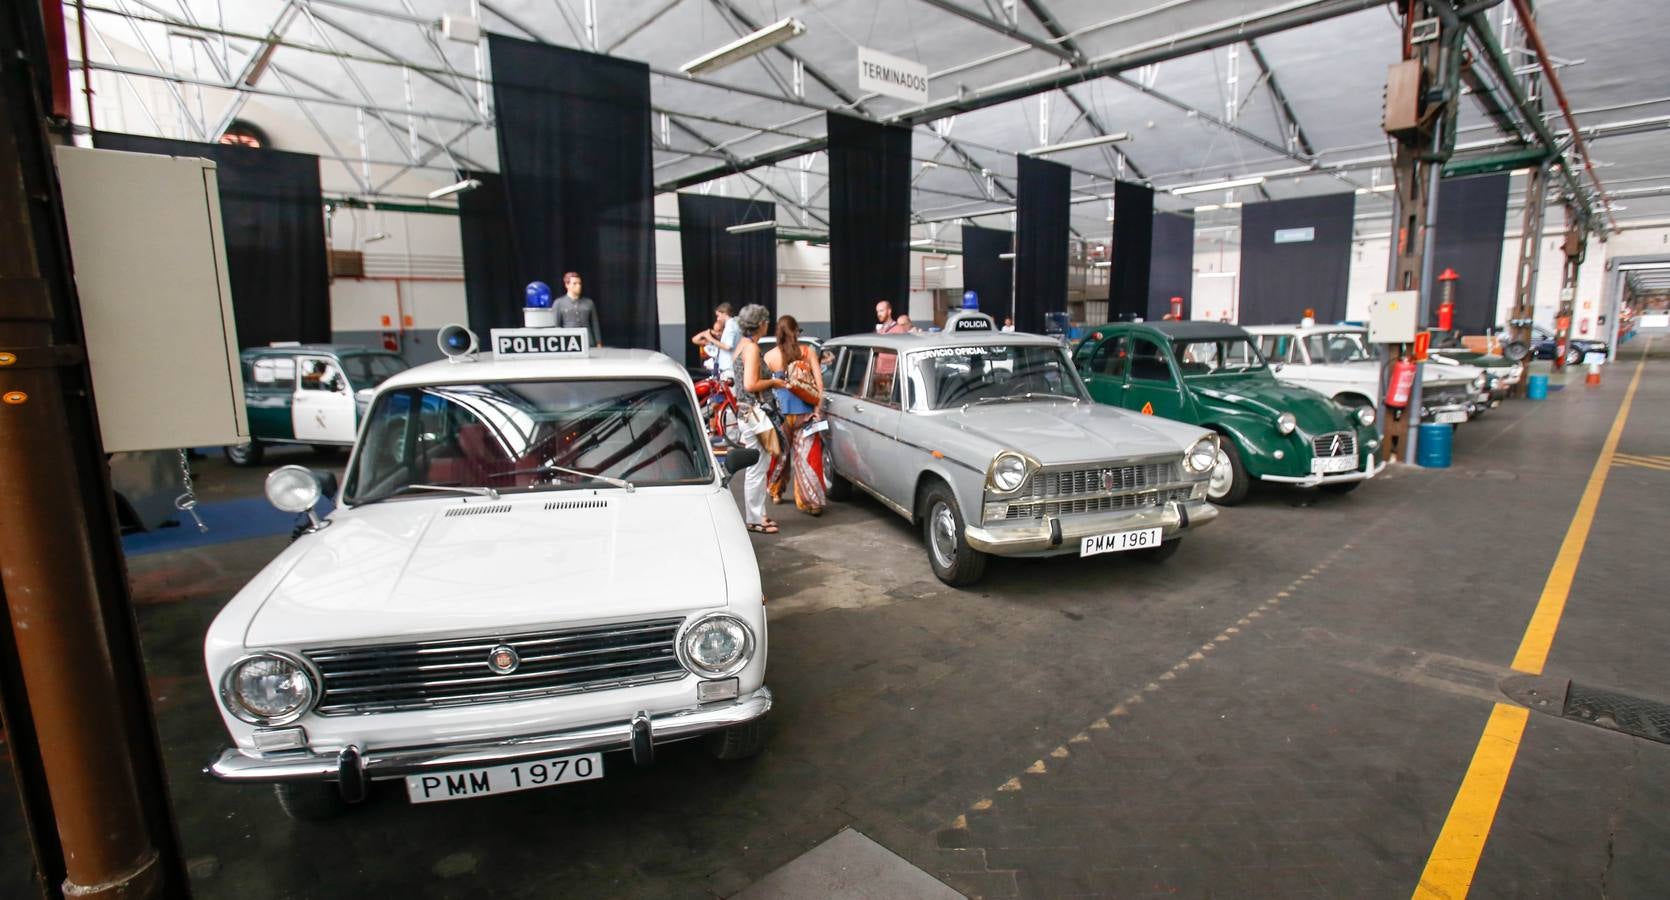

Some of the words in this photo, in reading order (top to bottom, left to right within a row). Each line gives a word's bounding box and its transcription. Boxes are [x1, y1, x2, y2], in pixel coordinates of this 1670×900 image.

[863, 61, 926, 91] TERMINADOS
[958, 320, 988, 329] POLICIA
[500, 336, 581, 353] POLICIA
[955, 347, 987, 355] OFICIAL
[1086, 536, 1115, 553] PMM
[1123, 531, 1155, 547] 1961
[422, 771, 490, 797] PMM
[511, 757, 592, 787] 1970
